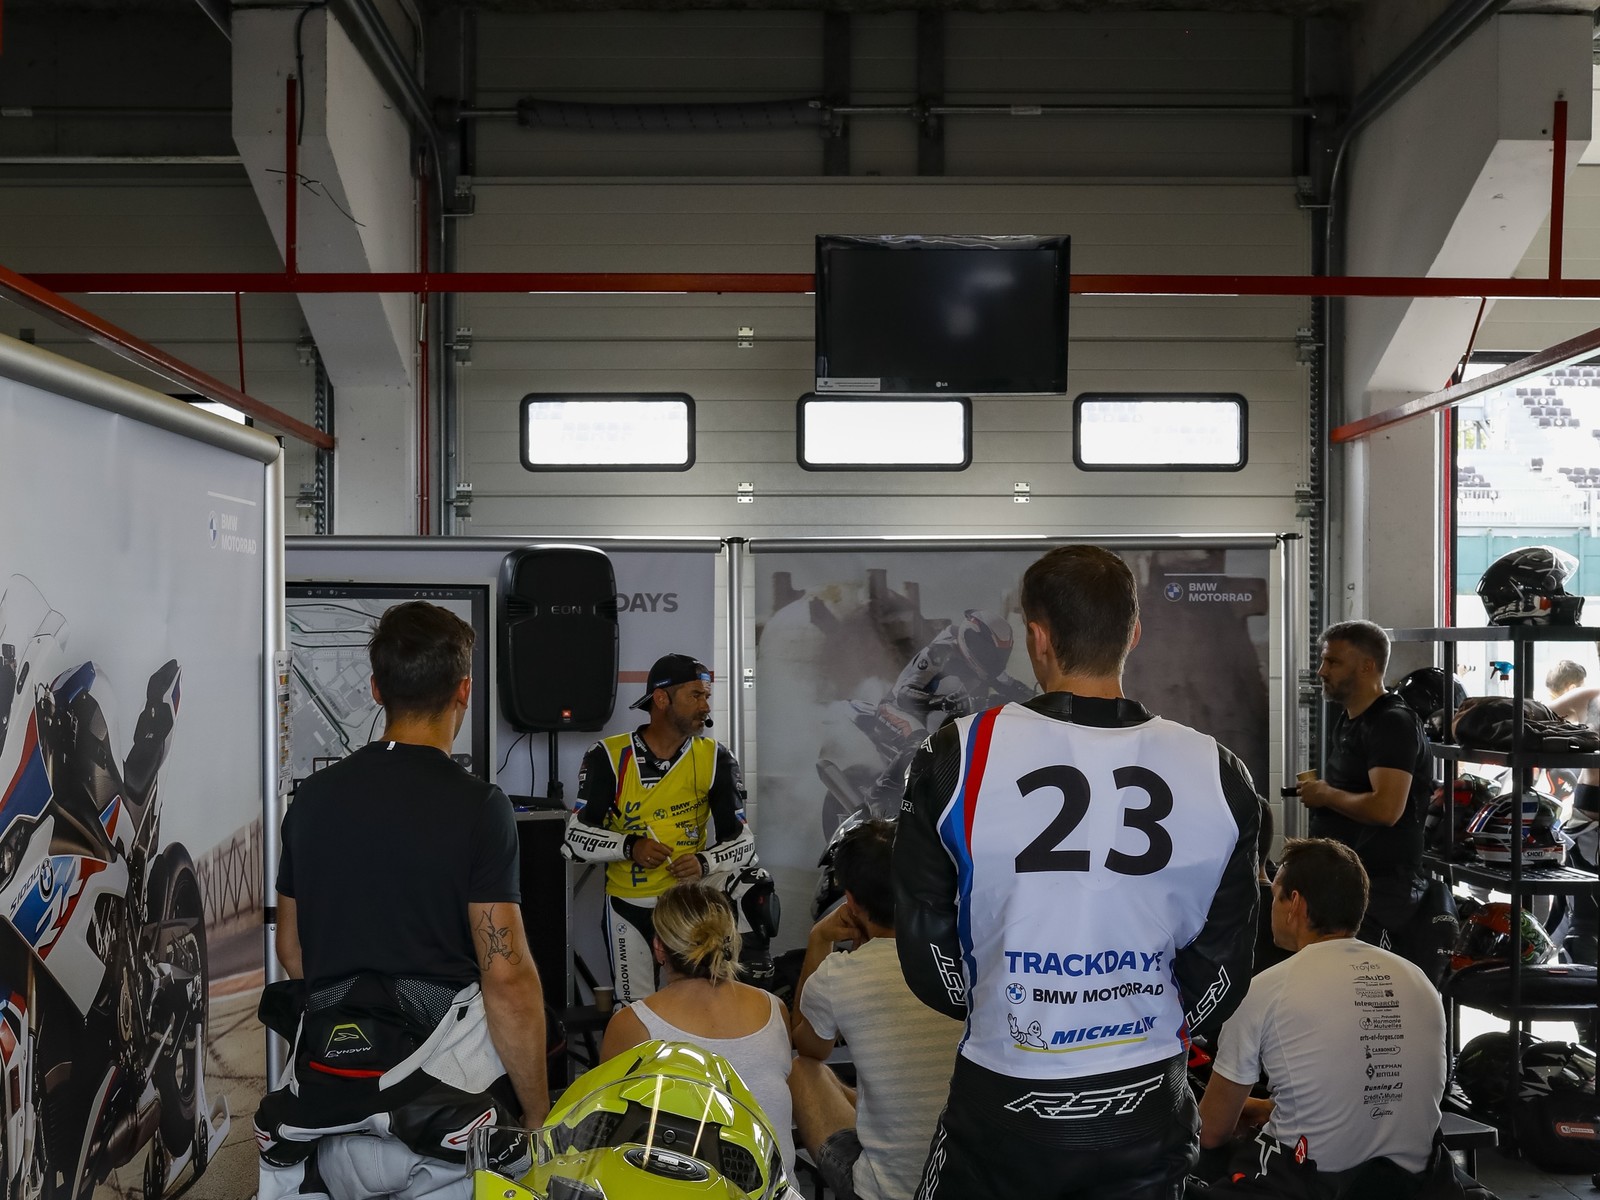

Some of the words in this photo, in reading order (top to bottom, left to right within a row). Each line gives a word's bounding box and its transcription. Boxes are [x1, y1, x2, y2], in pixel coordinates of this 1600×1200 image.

[221, 513, 238, 531] BMW
[221, 534, 257, 555] MOTORRAD
[1189, 583, 1218, 592] BMW
[1189, 593, 1252, 602] MOTORRAD
[551, 606, 582, 615] EON
[670, 801, 691, 812] BMW
[1014, 764, 1174, 876] 23
[618, 937, 628, 962] BMW
[620, 963, 631, 1001] MOTORR
[1033, 988, 1078, 1004] BMW
[1082, 982, 1164, 1003] MOTORRAD
[1003, 1073, 1165, 1119] RST
